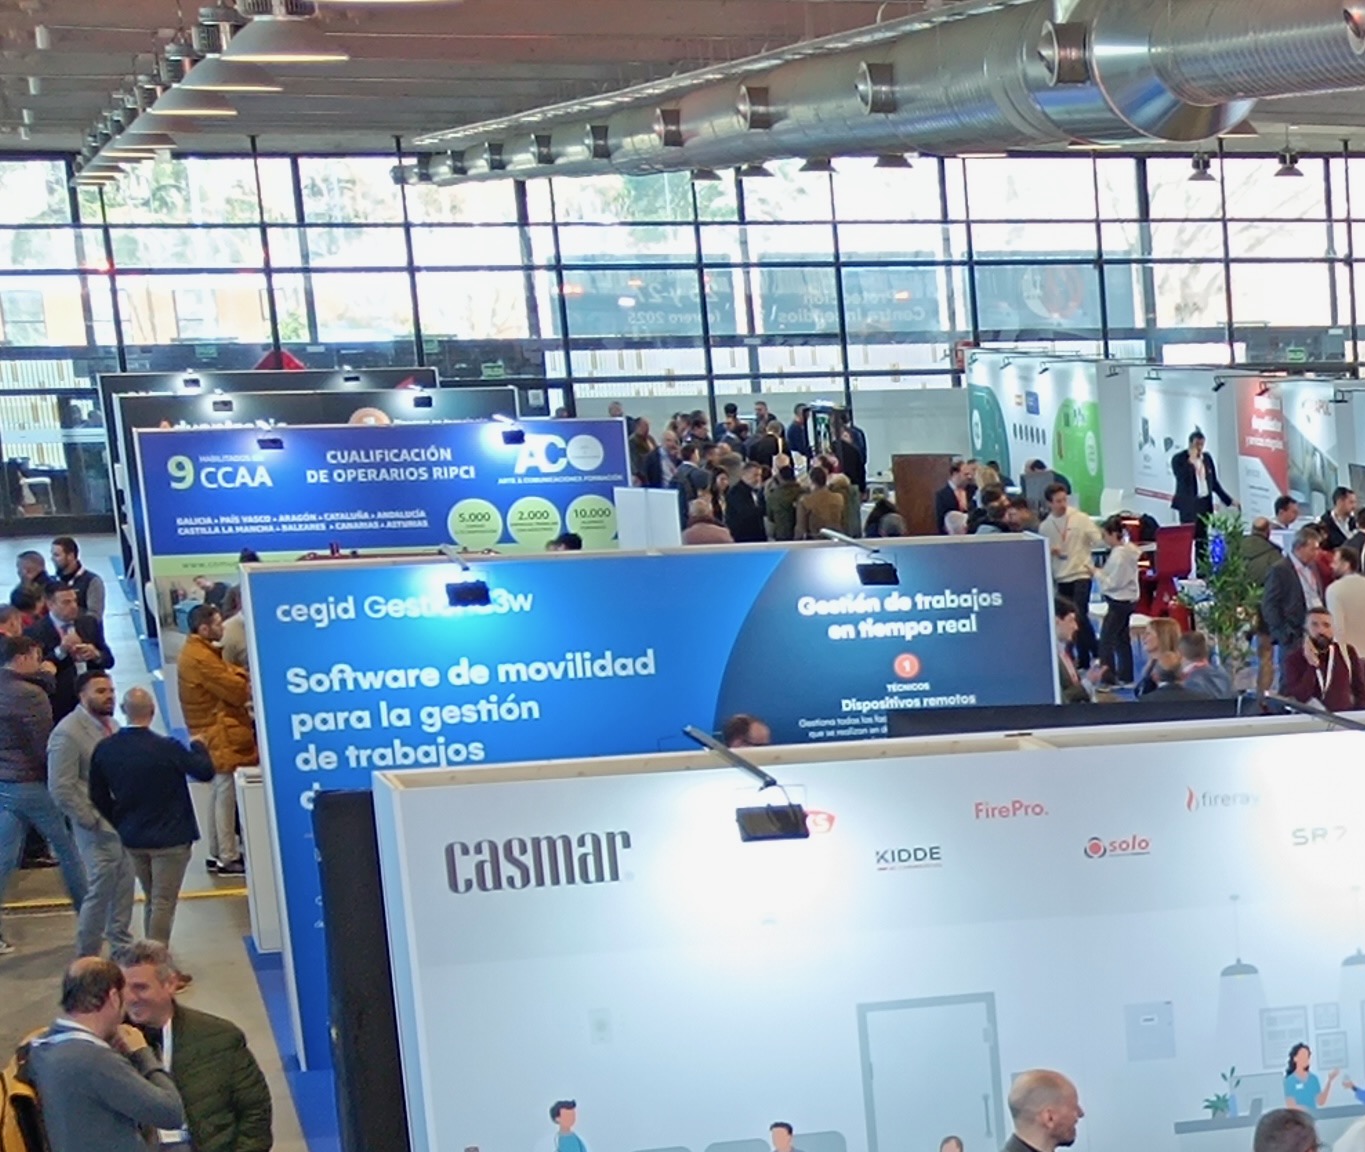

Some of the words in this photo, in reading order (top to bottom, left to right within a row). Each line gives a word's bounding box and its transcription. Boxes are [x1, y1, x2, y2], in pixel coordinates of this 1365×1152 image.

[326, 446, 452, 464] CUALIFICACIÓN
[167, 455, 195, 490] 9
[201, 466, 273, 488] CCAA
[306, 470, 329, 484] DE
[333, 466, 428, 482] OPERARIOS
[432, 466, 475, 480] RIPCI
[177, 517, 213, 526] GALICIA
[241, 515, 271, 524] VASCO
[278, 513, 317, 522] ARAGÓN
[459, 512, 491, 522] 5.000
[518, 510, 549, 521] 2.000
[574, 508, 611, 519] 10.000
[178, 526, 220, 536] CASTILLA
[276, 595, 355, 628] cegid
[798, 591, 881, 616] Gestión
[883, 592, 912, 613] de
[915, 588, 1003, 613] trabajos
[828, 624, 855, 641] en
[858, 617, 933, 641] tiempo
[937, 614, 977, 634] real
[286, 663, 440, 695] Software
[448, 657, 489, 685] de
[498, 649, 656, 684] movilidad
[886, 682, 930, 693] TÉCNICOS
[841, 695, 921, 713] Dispositivos
[923, 693, 976, 707] remotos
[291, 708, 371, 740] para
[380, 701, 411, 728] la
[420, 694, 540, 732] gestión
[799, 718, 835, 728] Gestiona
[295, 743, 338, 771] de
[346, 737, 485, 768] trabajos
[1108, 834, 1150, 854] solo
[444, 829, 632, 895] casmar
[875, 846, 942, 865] KIDDE
